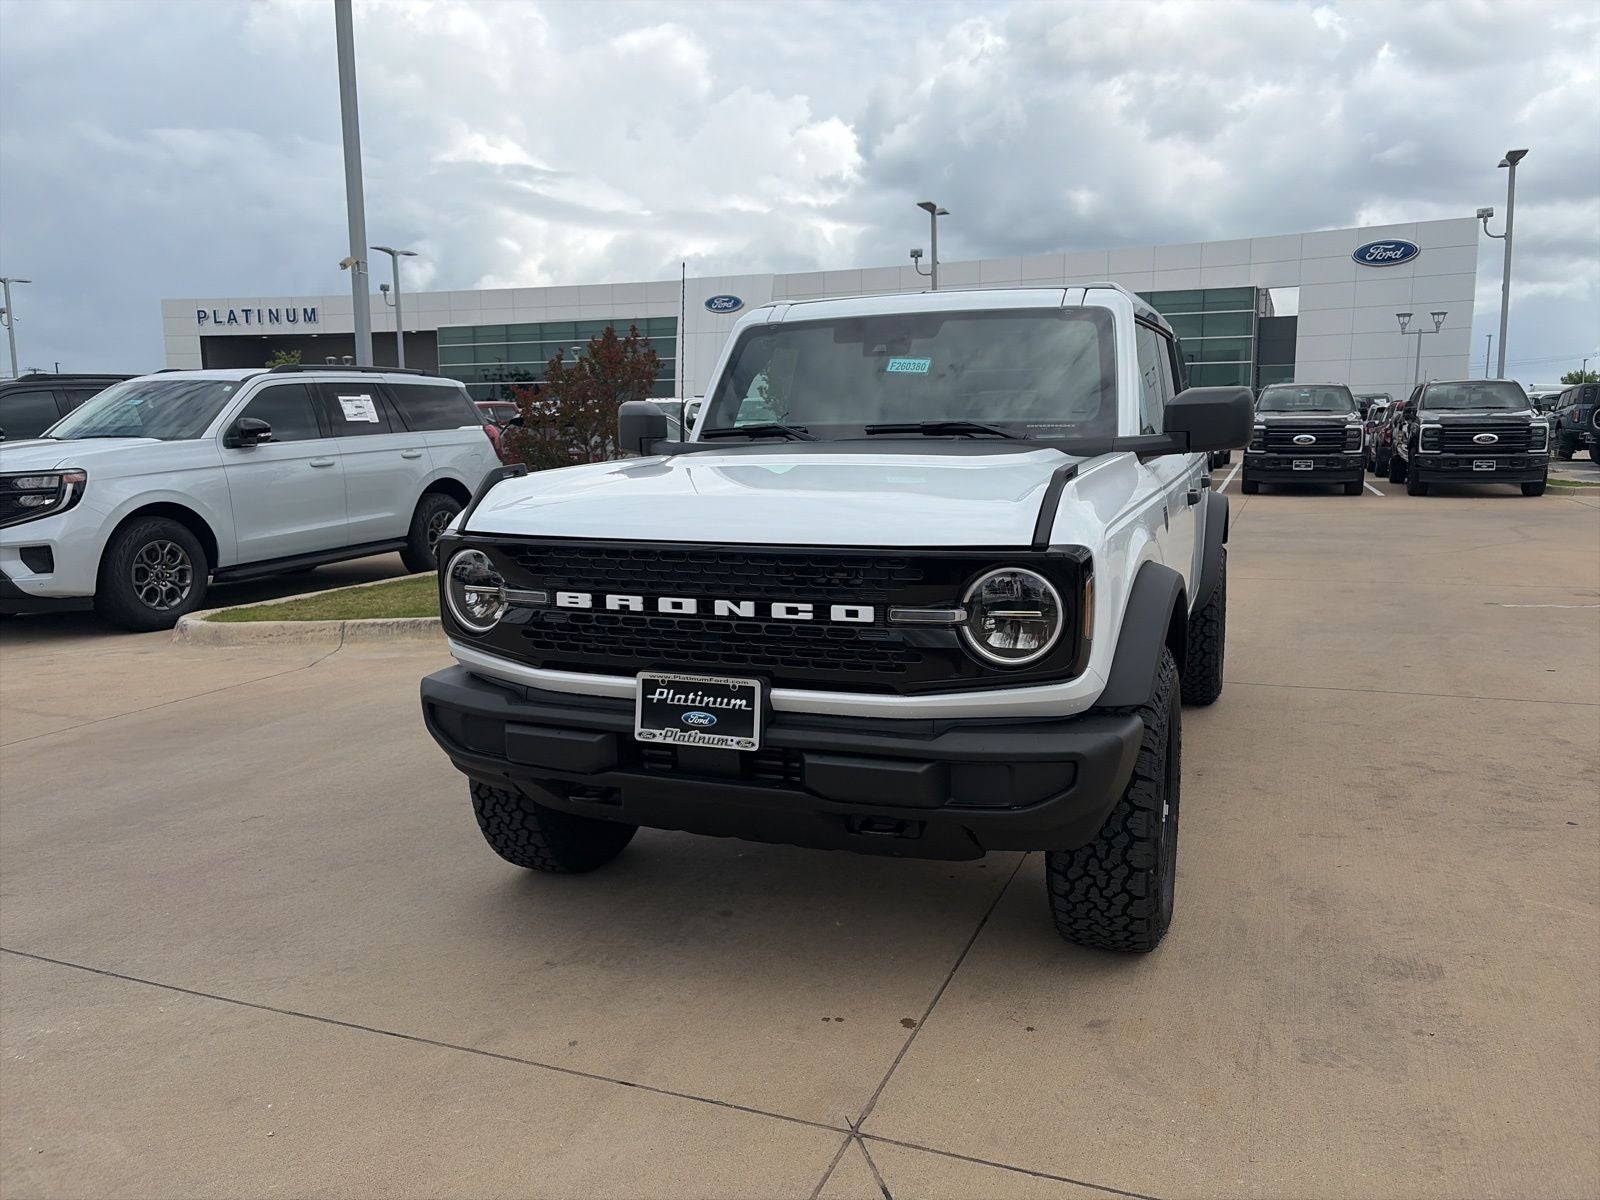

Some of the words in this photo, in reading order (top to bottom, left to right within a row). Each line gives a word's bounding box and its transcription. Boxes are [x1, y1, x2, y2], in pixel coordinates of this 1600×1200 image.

[1365, 244, 1405, 261] Ford
[712, 298, 734, 308] Ford
[196, 307, 319, 325] PLATINUM
[556, 591, 875, 623] BRONCO
[648, 674, 749, 685] www.PlatinumFord.com
[646, 688, 752, 710] Platinum
[688, 714, 710, 724] Ford
[663, 729, 733, 747] Platinum
